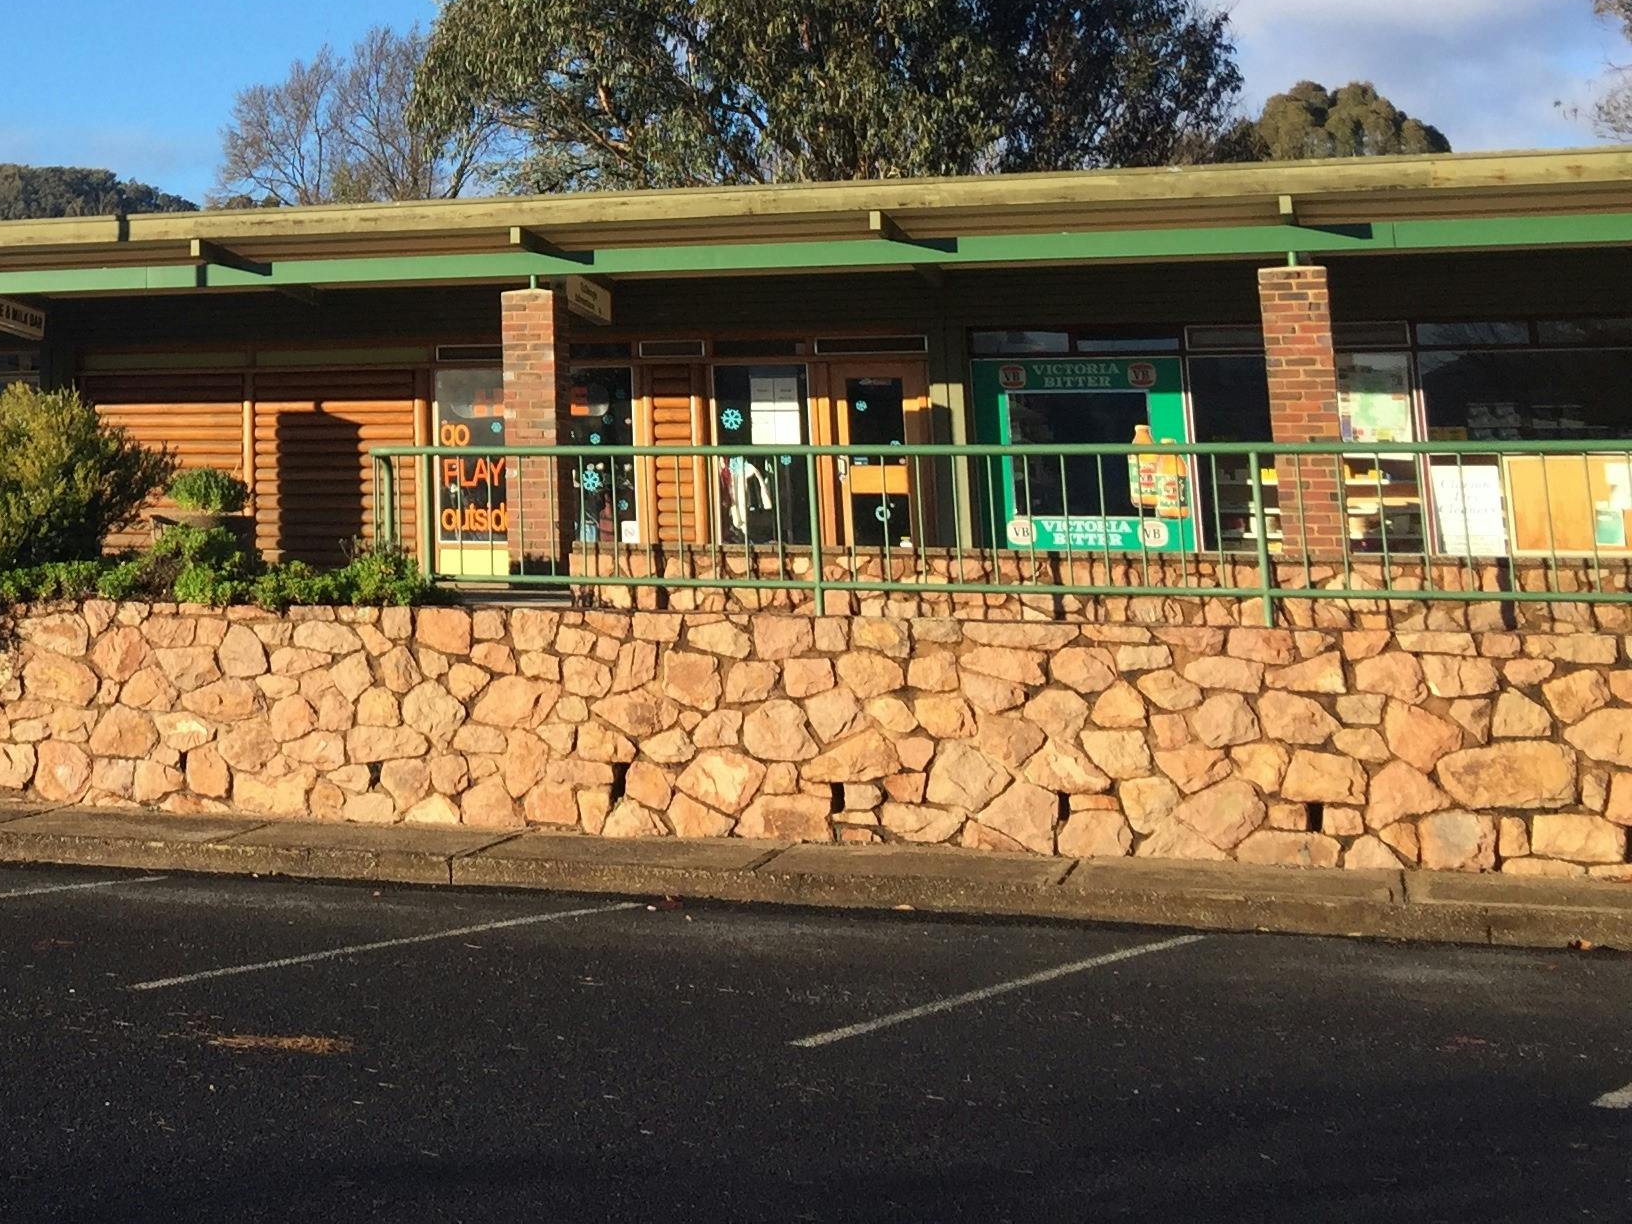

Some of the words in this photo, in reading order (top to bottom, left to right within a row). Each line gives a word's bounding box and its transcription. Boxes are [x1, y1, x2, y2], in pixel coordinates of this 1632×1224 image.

[1032, 363, 1120, 375] VICTORIA
[1132, 369, 1150, 380] VB
[1044, 376, 1111, 388] BITTER
[441, 424, 470, 447] go
[444, 458, 505, 487] PLAY
[441, 502, 508, 532] outsid
[1013, 527, 1030, 537] VB
[1041, 520, 1132, 533] VICTORIA
[1053, 533, 1123, 546] BITTER
[1144, 528, 1161, 539] VB
